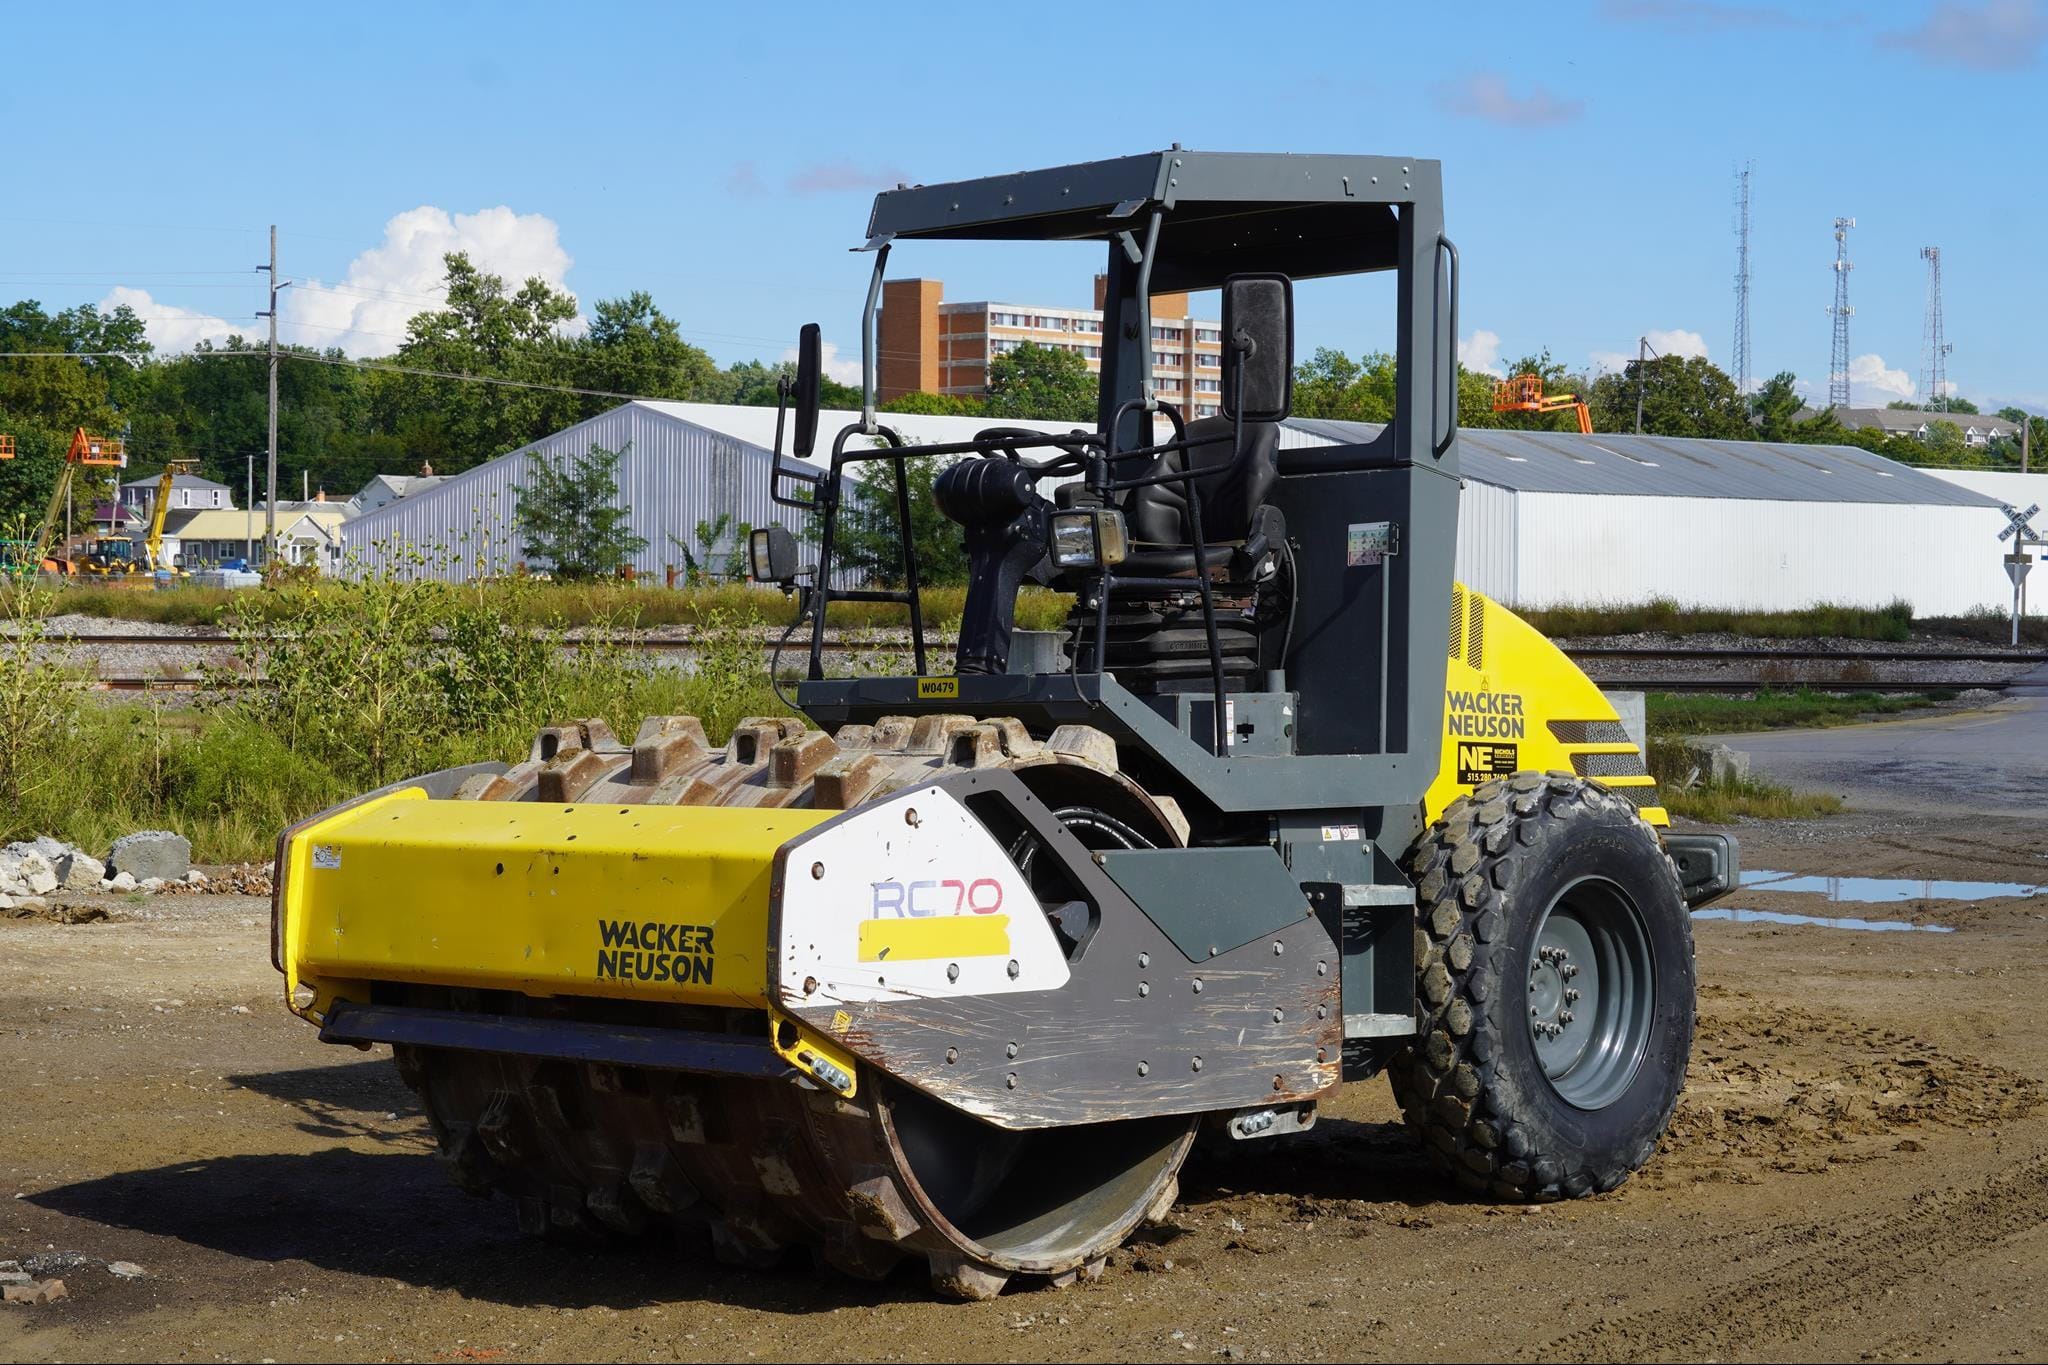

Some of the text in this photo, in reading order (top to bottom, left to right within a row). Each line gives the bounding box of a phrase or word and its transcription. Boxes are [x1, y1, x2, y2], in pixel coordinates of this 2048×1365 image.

[2000, 505, 2039, 541] CROSSING
[922, 682, 954, 693] W0479
[1447, 690, 1524, 716] WACKER
[1449, 714, 1525, 738] NEUSON
[1460, 746, 1493, 771] NE
[873, 878, 1003, 919] RC70
[599, 920, 715, 954] WACKER
[597, 949, 714, 985] NEUSON
